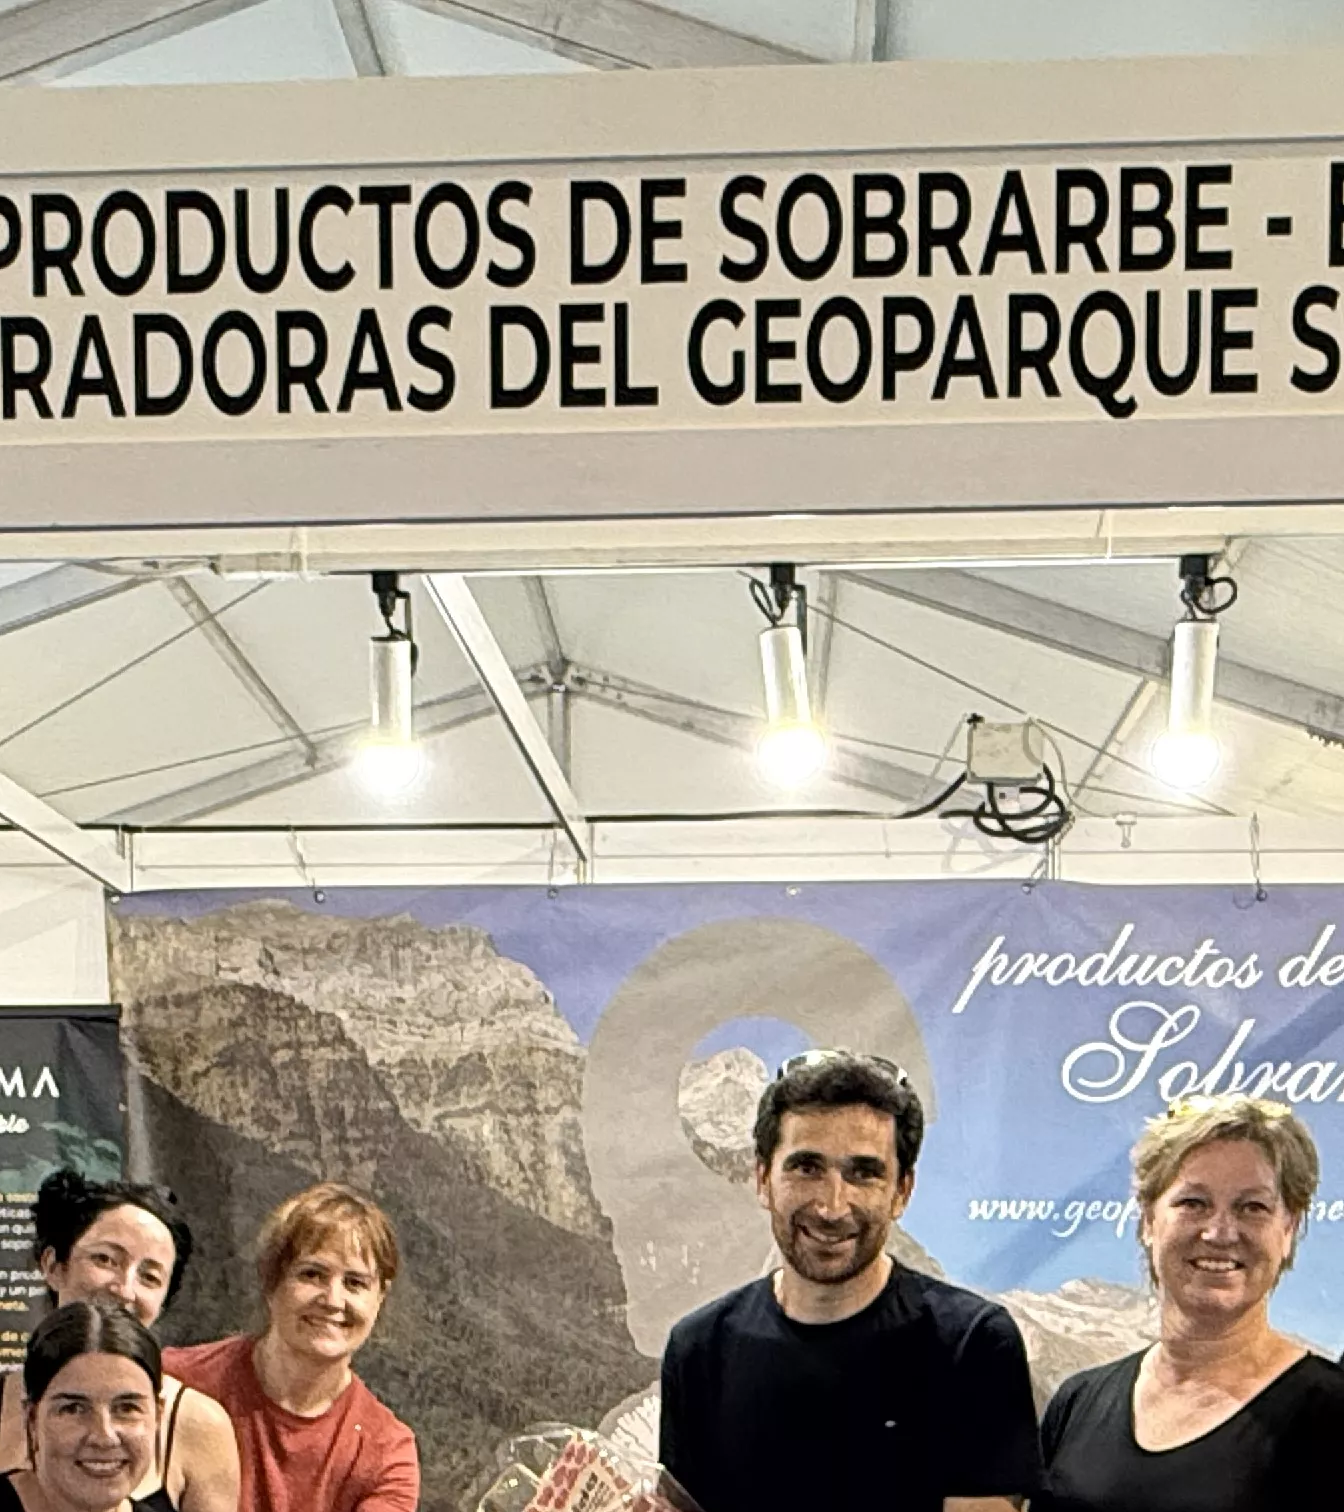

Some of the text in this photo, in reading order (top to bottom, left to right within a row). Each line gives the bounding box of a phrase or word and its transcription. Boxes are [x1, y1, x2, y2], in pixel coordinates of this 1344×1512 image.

[570, 178, 689, 285] DE
[718, 163, 1234, 282] SOBRARBE
[1266, 216, 1293, 236] -
[489, 300, 660, 410] DEL
[686, 286, 1260, 420] GEOPARQUE
[952, 922, 1263, 1014] productos
